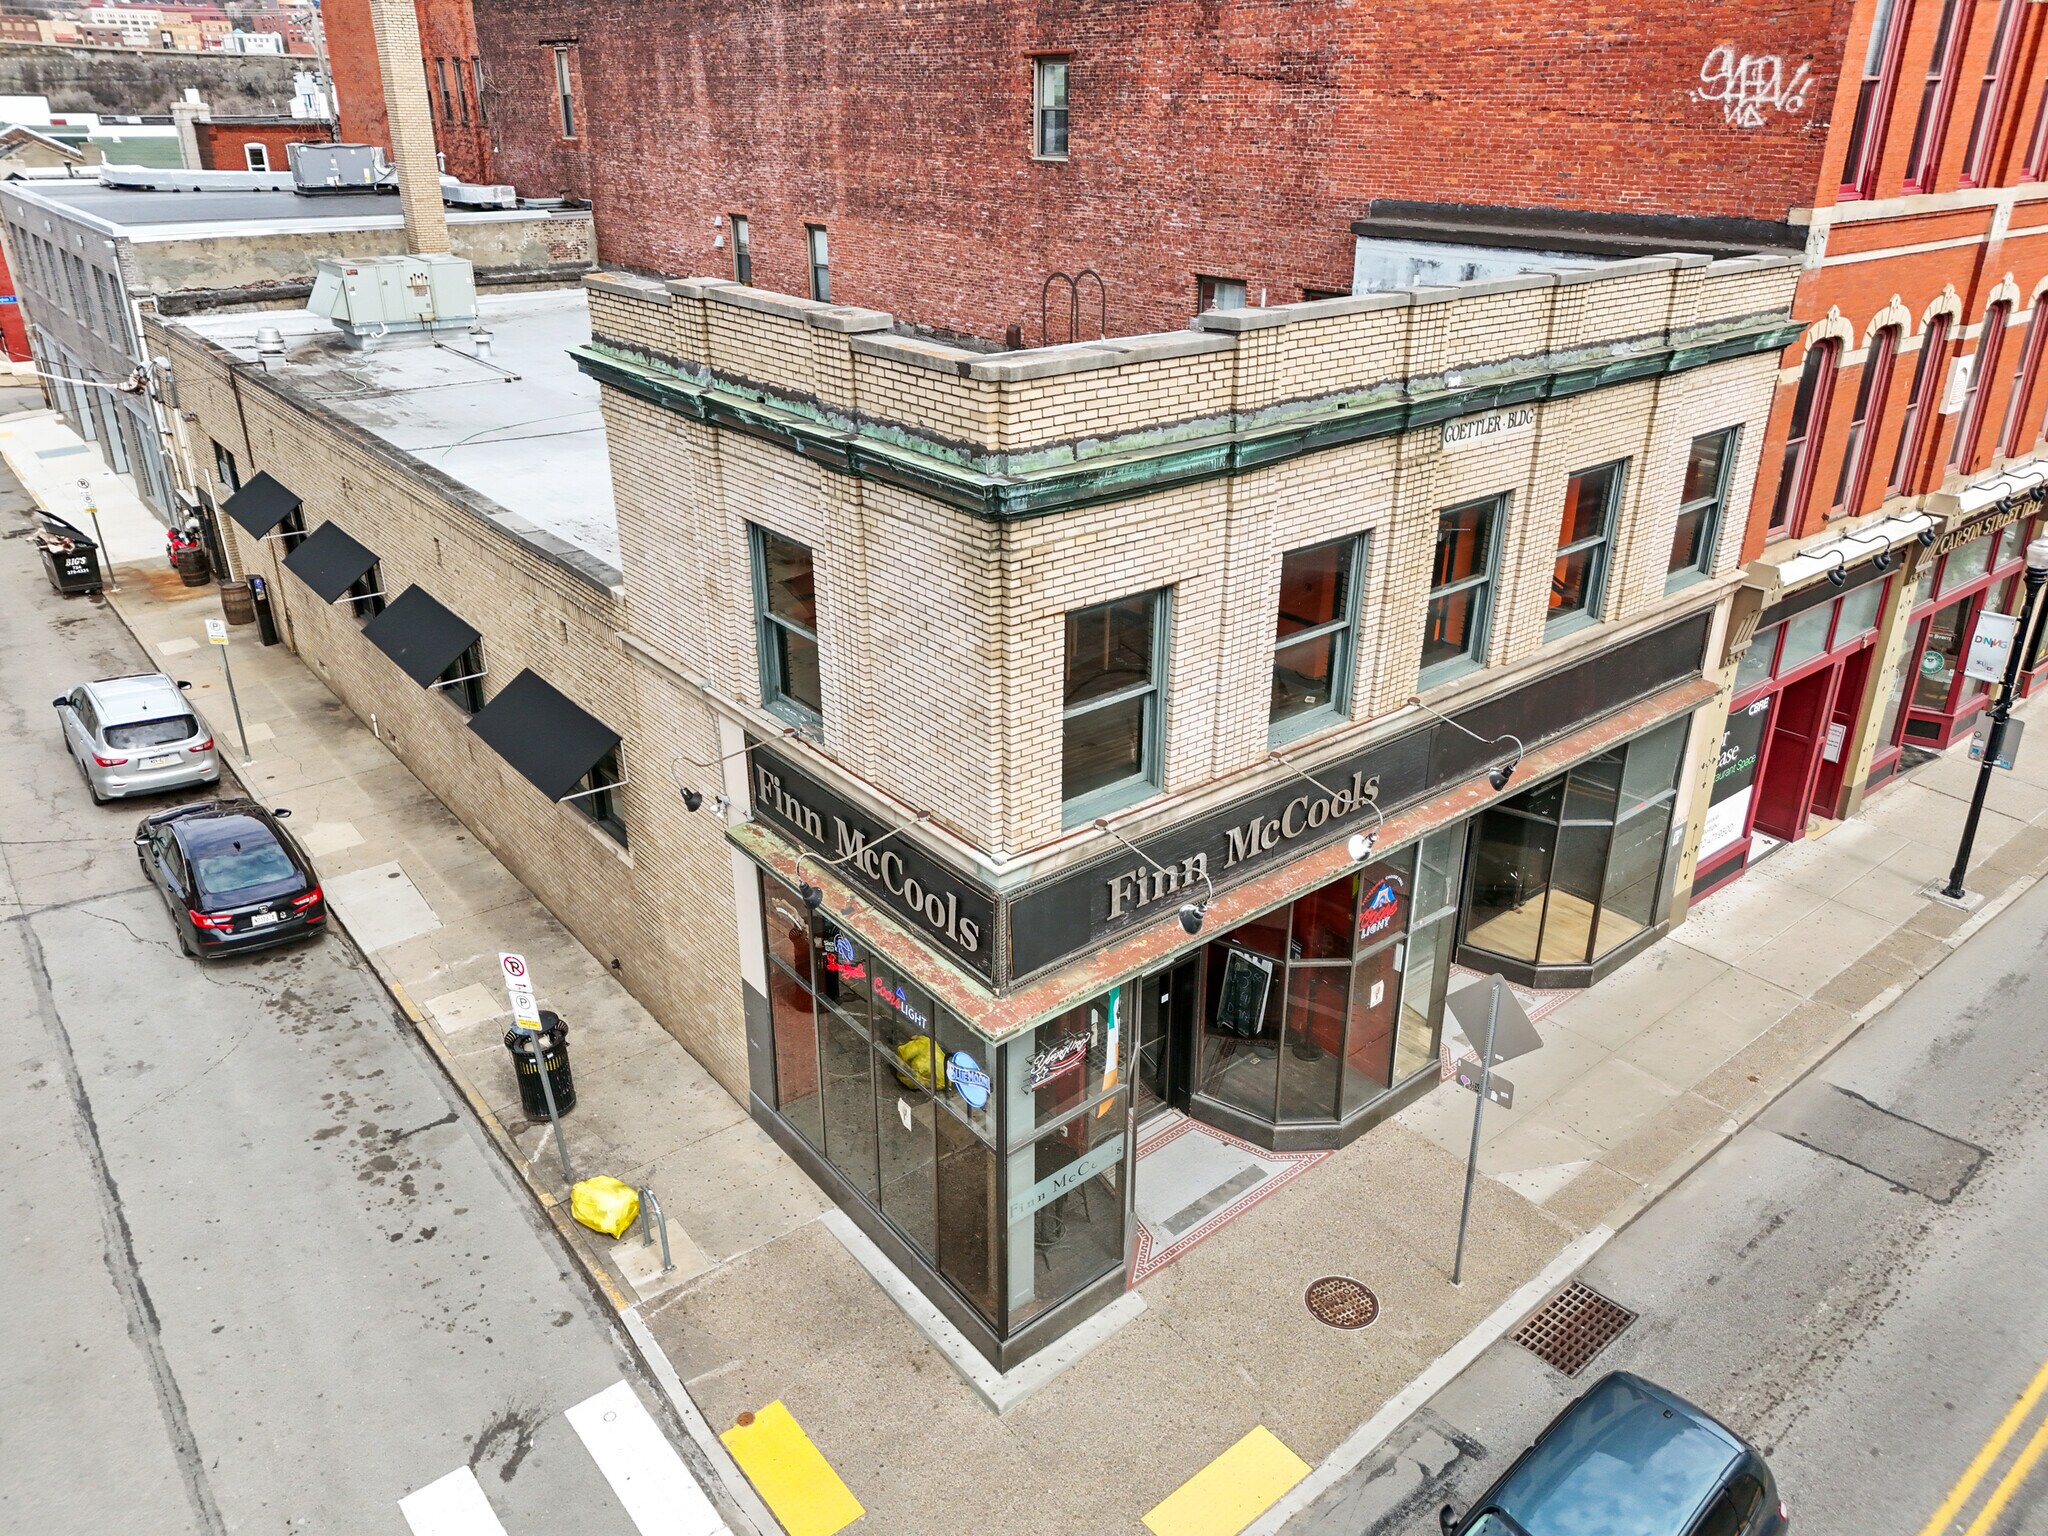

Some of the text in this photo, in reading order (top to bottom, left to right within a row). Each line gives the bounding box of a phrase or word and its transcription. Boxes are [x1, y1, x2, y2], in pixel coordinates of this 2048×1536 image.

[1444, 408, 1534, 443] GOETTLER BLDG
[1940, 520, 1984, 554] CARSON
[1974, 634, 2008, 649] DNING
[1748, 696, 1770, 716] CBRE
[1718, 745, 1740, 767] ase
[1736, 754, 1757, 772] Space
[756, 763, 980, 952] Finn McCools
[1106, 770, 1381, 922] Finn McCools
[1361, 916, 1390, 939] LIGHT
[873, 977, 928, 1029] Coors LIGHT
[1009, 1146, 1122, 1219] Finn McCs
